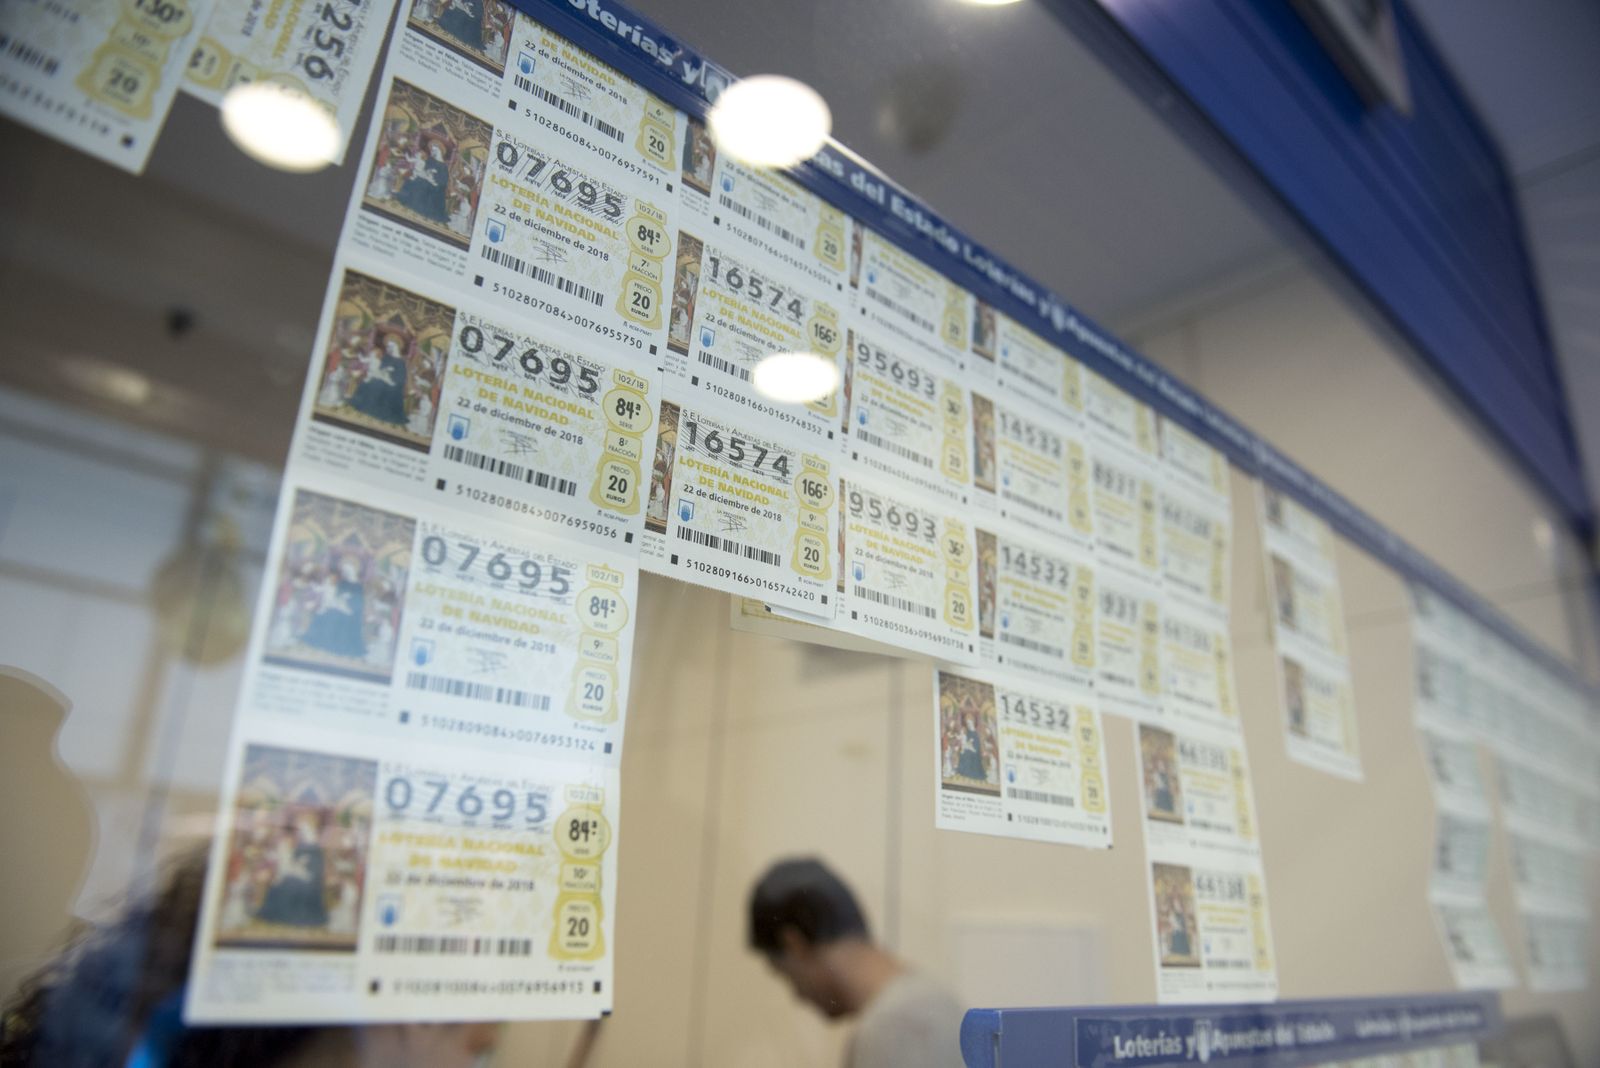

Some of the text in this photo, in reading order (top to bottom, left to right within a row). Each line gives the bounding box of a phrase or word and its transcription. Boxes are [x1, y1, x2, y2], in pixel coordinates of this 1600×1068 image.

[303, 0, 361, 80] 256
[567, 0, 674, 66] oterías
[681, 61, 700, 85] y
[525, 40, 537, 53] 22
[538, 47, 550, 60] de
[552, 52, 594, 85] diciembre
[597, 80, 607, 94] de
[608, 88, 628, 105] 2018
[540, 36, 560, 53] DE
[561, 46, 616, 86] NAVIDAD
[525, 108, 660, 186] 5102806084>0076957591
[649, 135, 665, 153] 20
[496, 140, 622, 218] 07695
[512, 198, 597, 243] DE NAVIDAD
[553, 198, 620, 240] NACIONAL
[640, 203, 663, 219] 102/18
[851, 171, 960, 254] del Estado
[494, 203, 507, 216] 22
[509, 208, 521, 221] de
[524, 213, 571, 245] diciembre
[574, 239, 585, 252] de
[587, 243, 610, 262] 2018
[824, 239, 838, 255] 20
[632, 291, 650, 310] 20
[709, 256, 804, 320] 16574
[493, 282, 643, 349] 5102807084>0076955750
[631, 307, 649, 319] EUROS
[719, 307, 785, 343] DE NAVIDAD
[752, 303, 800, 339] NACIONAL
[705, 313, 777, 350] 22 de diciembre de
[460, 325, 598, 394] 07695
[577, 355, 606, 374] ESTADO
[857, 343, 936, 396] 95693
[618, 373, 644, 390] 102/18
[457, 396, 584, 445] 22 de diciembre de 2018
[478, 387, 569, 426] DE NAVIDAD
[522, 386, 594, 420] NACIONAL
[608, 444, 636, 460] FRACCIÓN
[686, 421, 790, 478] 16574
[805, 458, 826, 471] 102/18
[608, 475, 627, 494] 20
[611, 464, 630, 476] PRECIO
[733, 473, 789, 500] NACIONAL
[606, 493, 626, 504] EUROS
[683, 484, 782, 522] 22 de diciembre de 2018
[699, 476, 770, 505] DE NAVIDAD
[456, 484, 617, 539] 5102808084>0076959056
[850, 491, 936, 539] 95693
[421, 535, 571, 597] 07695
[804, 547, 820, 563] 20
[1001, 545, 1069, 587] 14532
[591, 568, 619, 584] 102/18
[686, 559, 815, 601] 5102809166>0165742420
[441, 604, 540, 636] DE NAVIDAD
[490, 597, 567, 625] NACIONAL
[952, 599, 965, 615] 20
[419, 617, 557, 655] 22 de diciembre de 2018
[584, 682, 604, 702] 20
[1001, 695, 1069, 729] 14532
[385, 776, 548, 824] 07695
[567, 916, 590, 937] 20
[1114, 1031, 1182, 1060] Loterías
